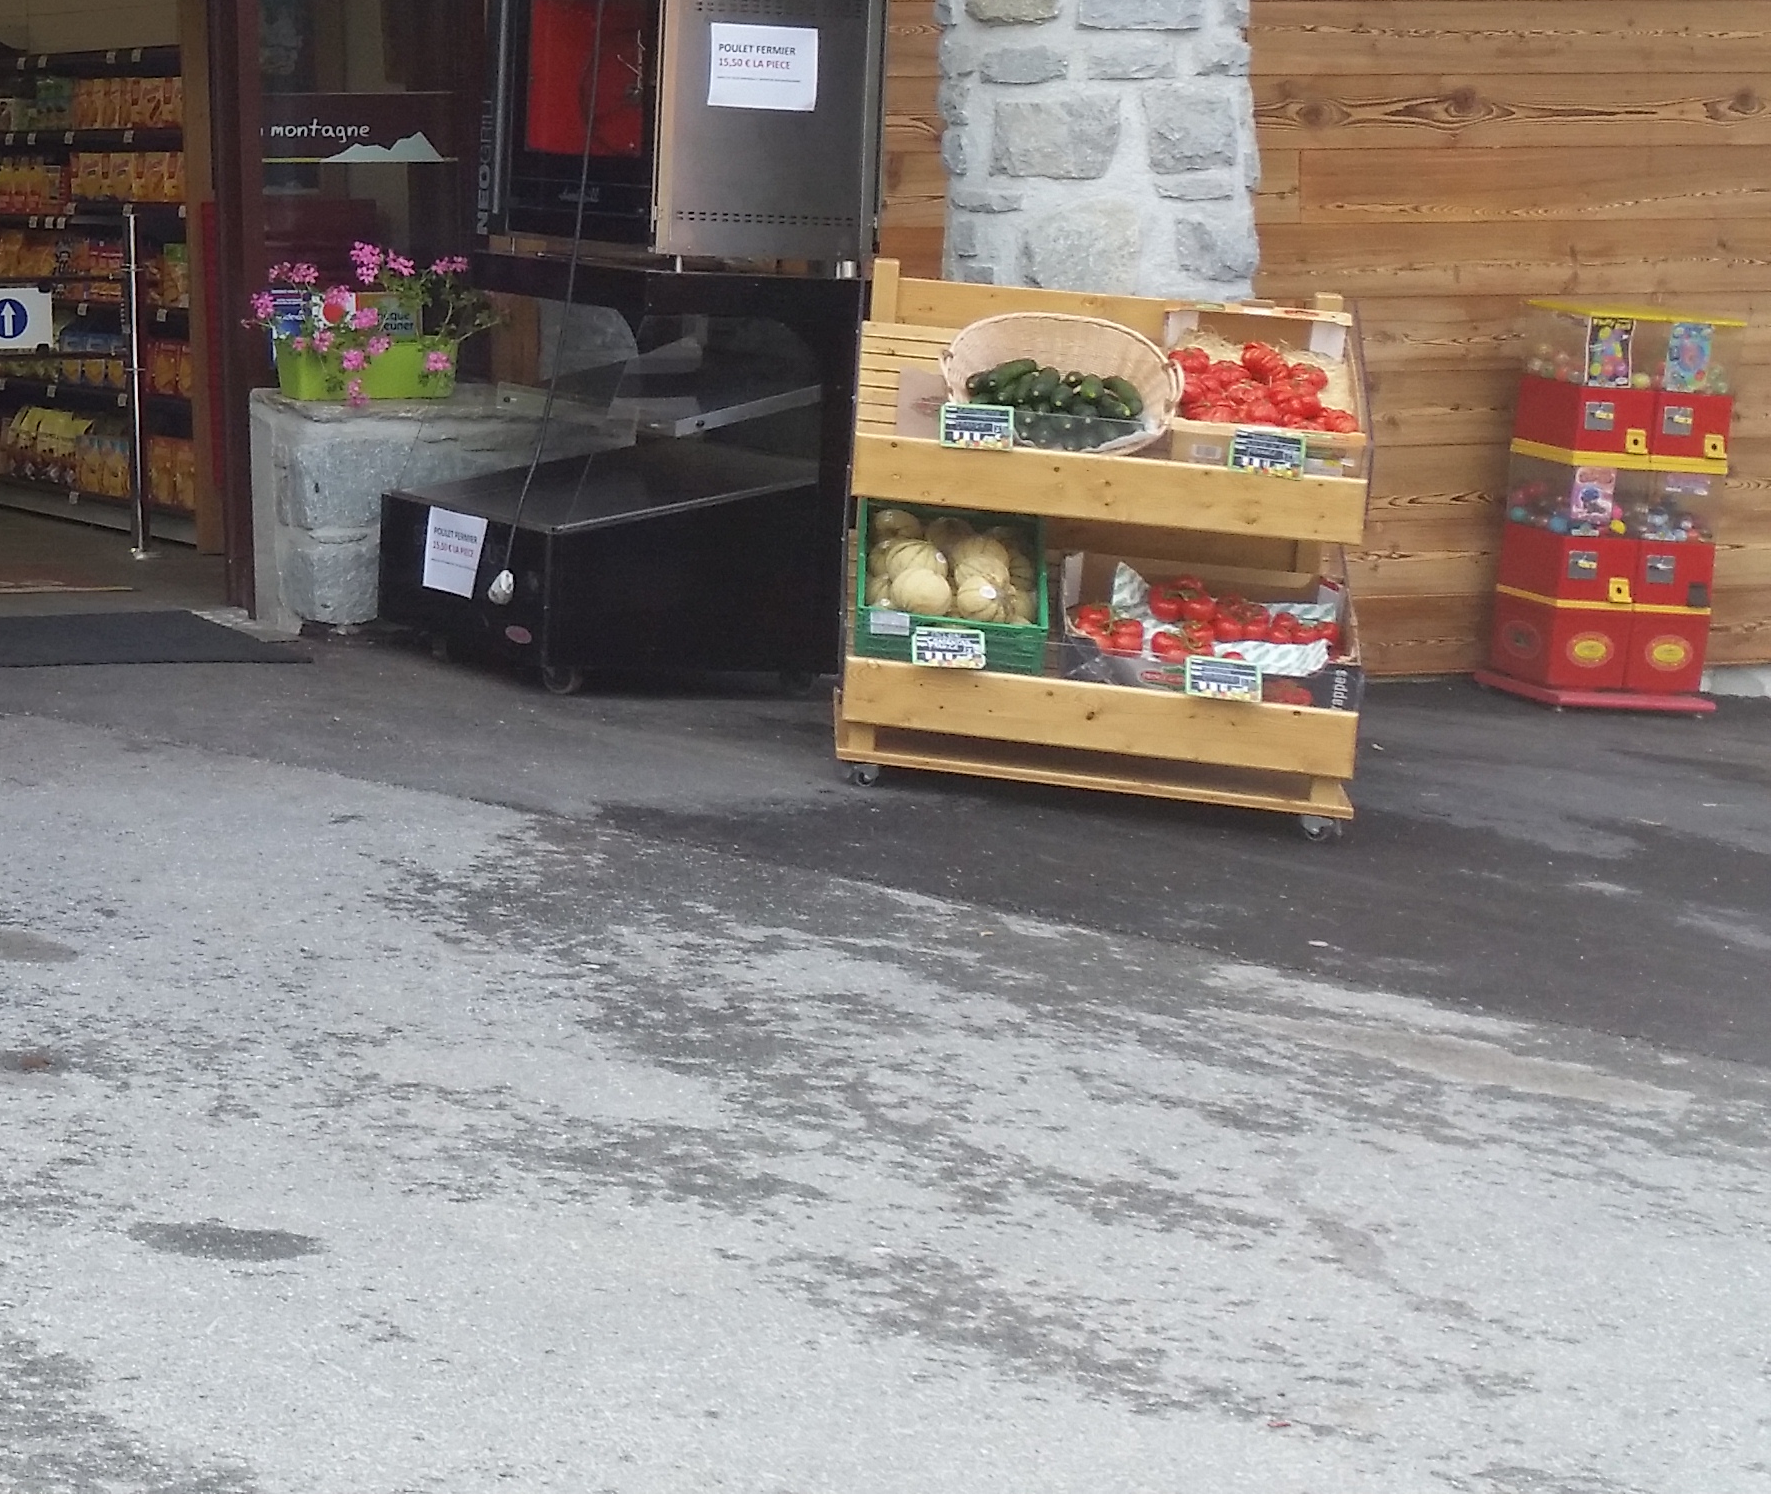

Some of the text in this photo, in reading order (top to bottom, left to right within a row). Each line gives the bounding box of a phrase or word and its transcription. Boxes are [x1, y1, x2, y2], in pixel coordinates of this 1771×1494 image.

[718, 43, 796, 56] POULET FERMIER
[753, 60, 764, 68] LA
[270, 118, 371, 144] montagne
